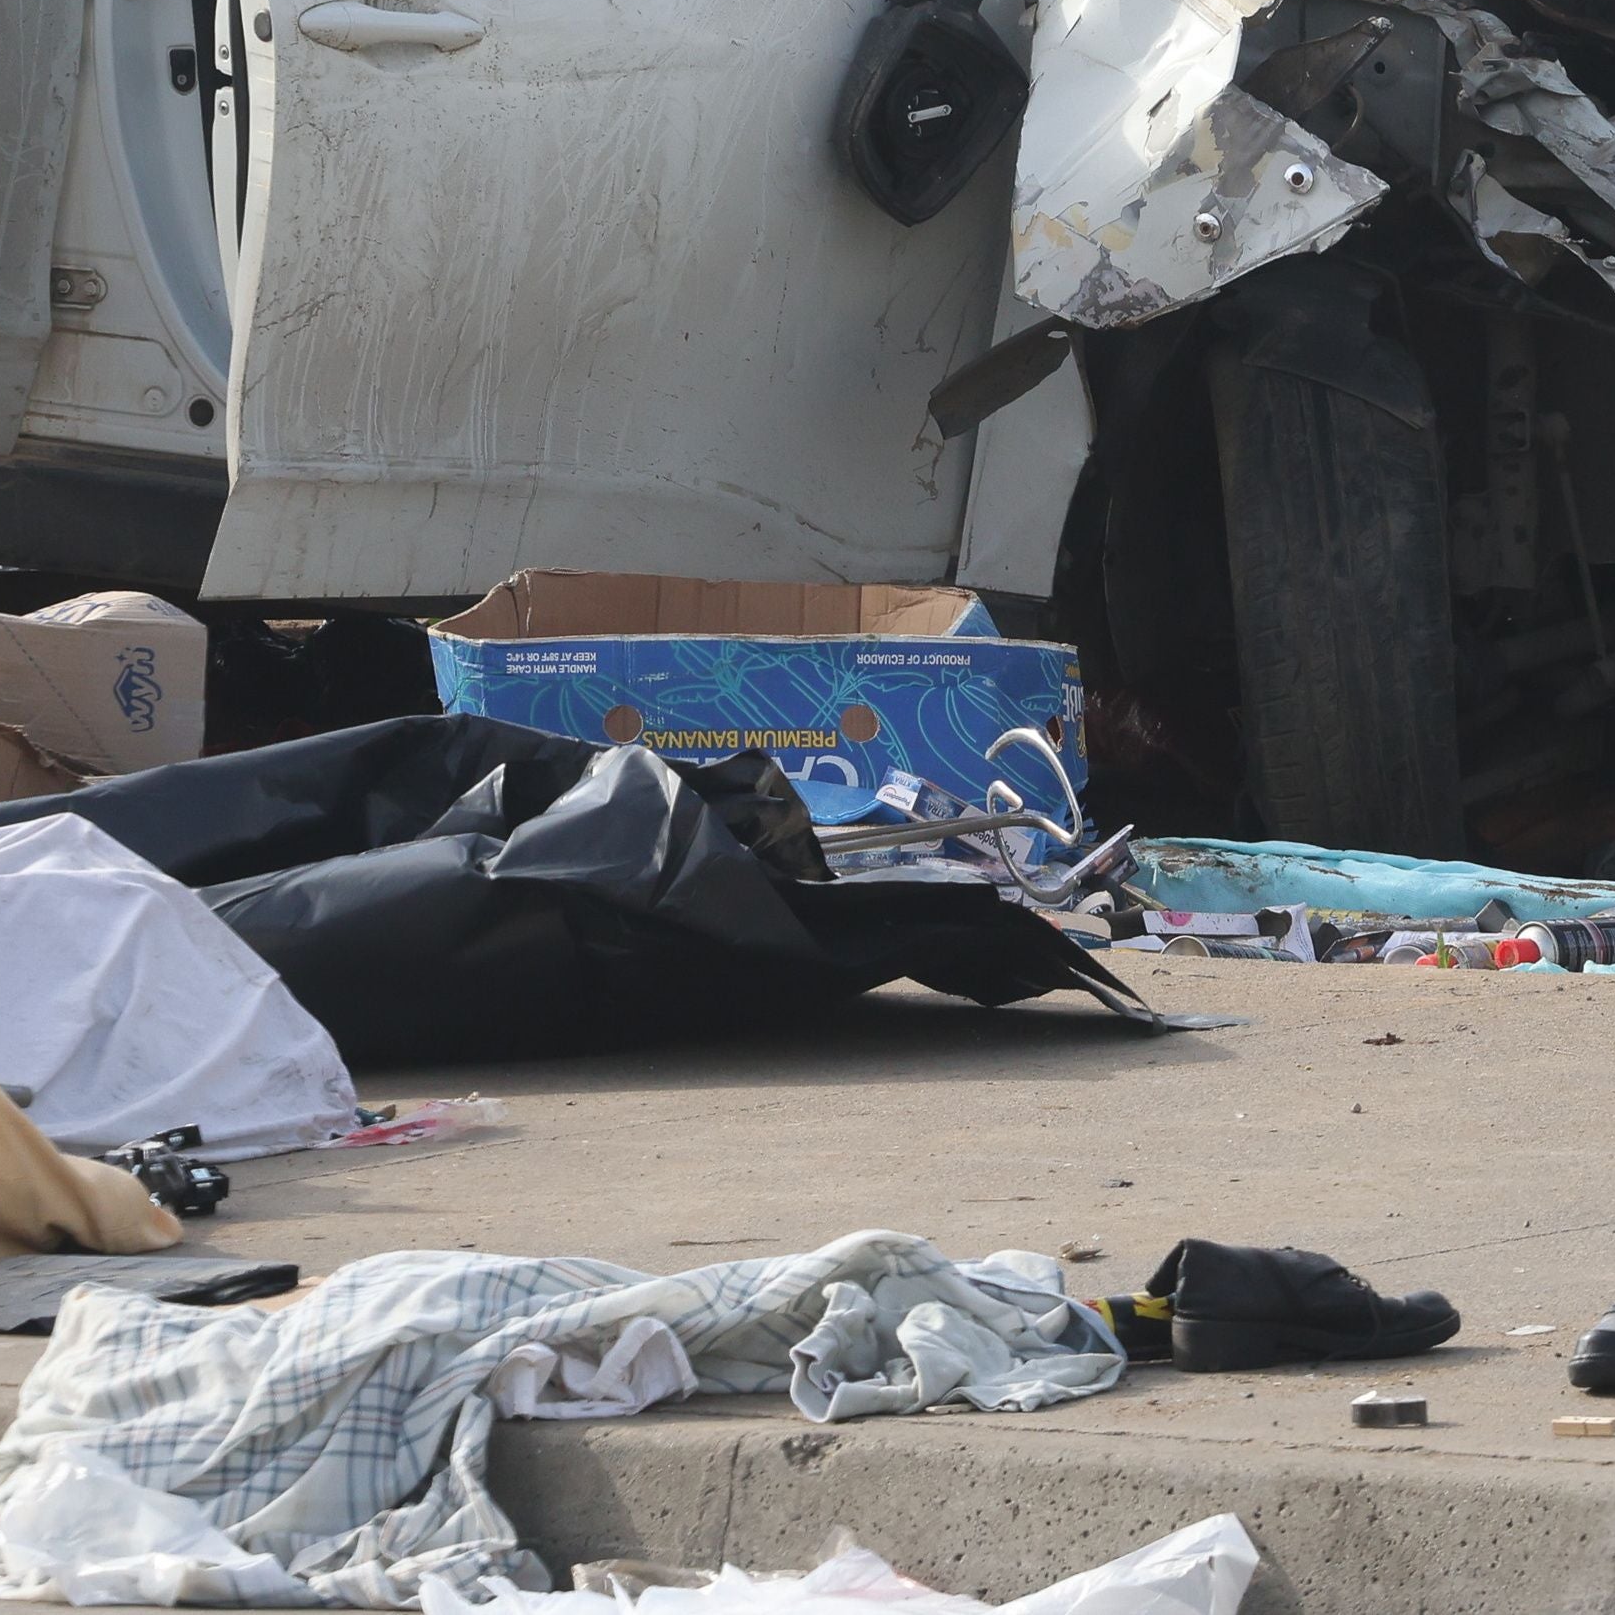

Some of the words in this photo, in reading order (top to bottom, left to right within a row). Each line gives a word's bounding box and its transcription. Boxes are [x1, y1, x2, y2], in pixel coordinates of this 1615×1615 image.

[527, 652, 540, 662] OR
[561, 652, 572, 661] AT
[572, 652, 597, 661] KEEP
[856, 653, 905, 665] ECUADOR
[907, 654, 921, 665] OF
[923, 654, 971, 665] PRODUCT
[506, 664, 531, 674] CARE
[533, 665, 557, 674] WITH
[558, 664, 597, 673] HANDLE
[641, 730, 739, 748] BANANAS
[745, 730, 837, 749] PREMIUM
[926, 803, 947, 818] XTRA
